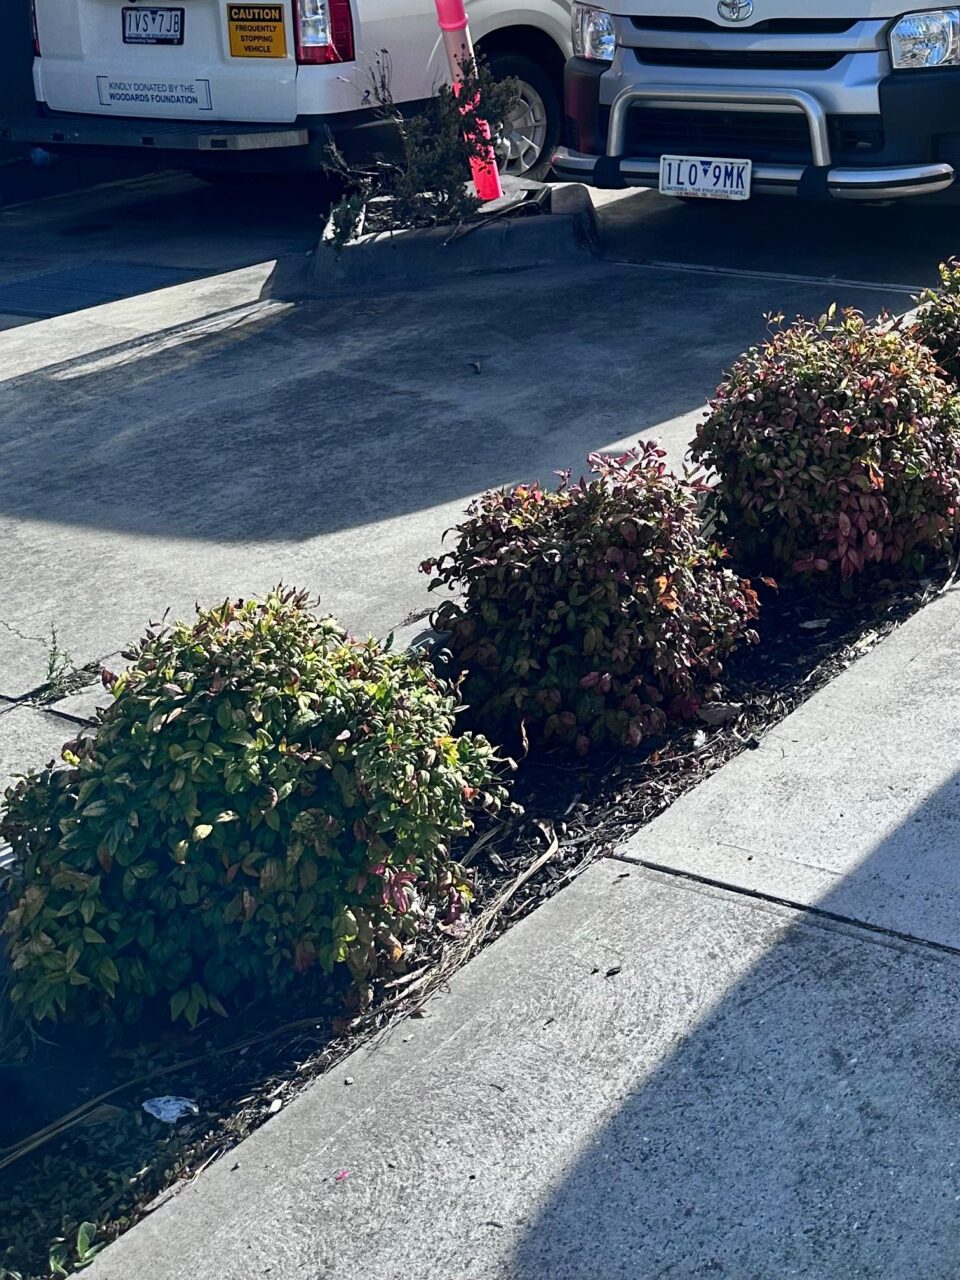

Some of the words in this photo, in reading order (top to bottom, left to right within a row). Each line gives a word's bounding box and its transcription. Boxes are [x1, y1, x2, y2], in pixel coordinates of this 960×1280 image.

[231, 9, 280, 20] CAUTION
[128, 13, 149, 32] 1VS
[159, 14, 180, 32] 7JB
[235, 24, 277, 32] FREQUENTLY
[240, 35, 273, 43] STOPPING
[243, 45, 272, 53] VEHICLE
[109, 82, 132, 91] KINDLY
[134, 83, 167, 93] DONATED
[168, 84, 178, 93] BY
[180, 84, 195, 93] THE
[109, 93, 149, 103] WOODARDS
[151, 94, 198, 104] FOUNDATION
[712, 165, 745, 189] 9MK
